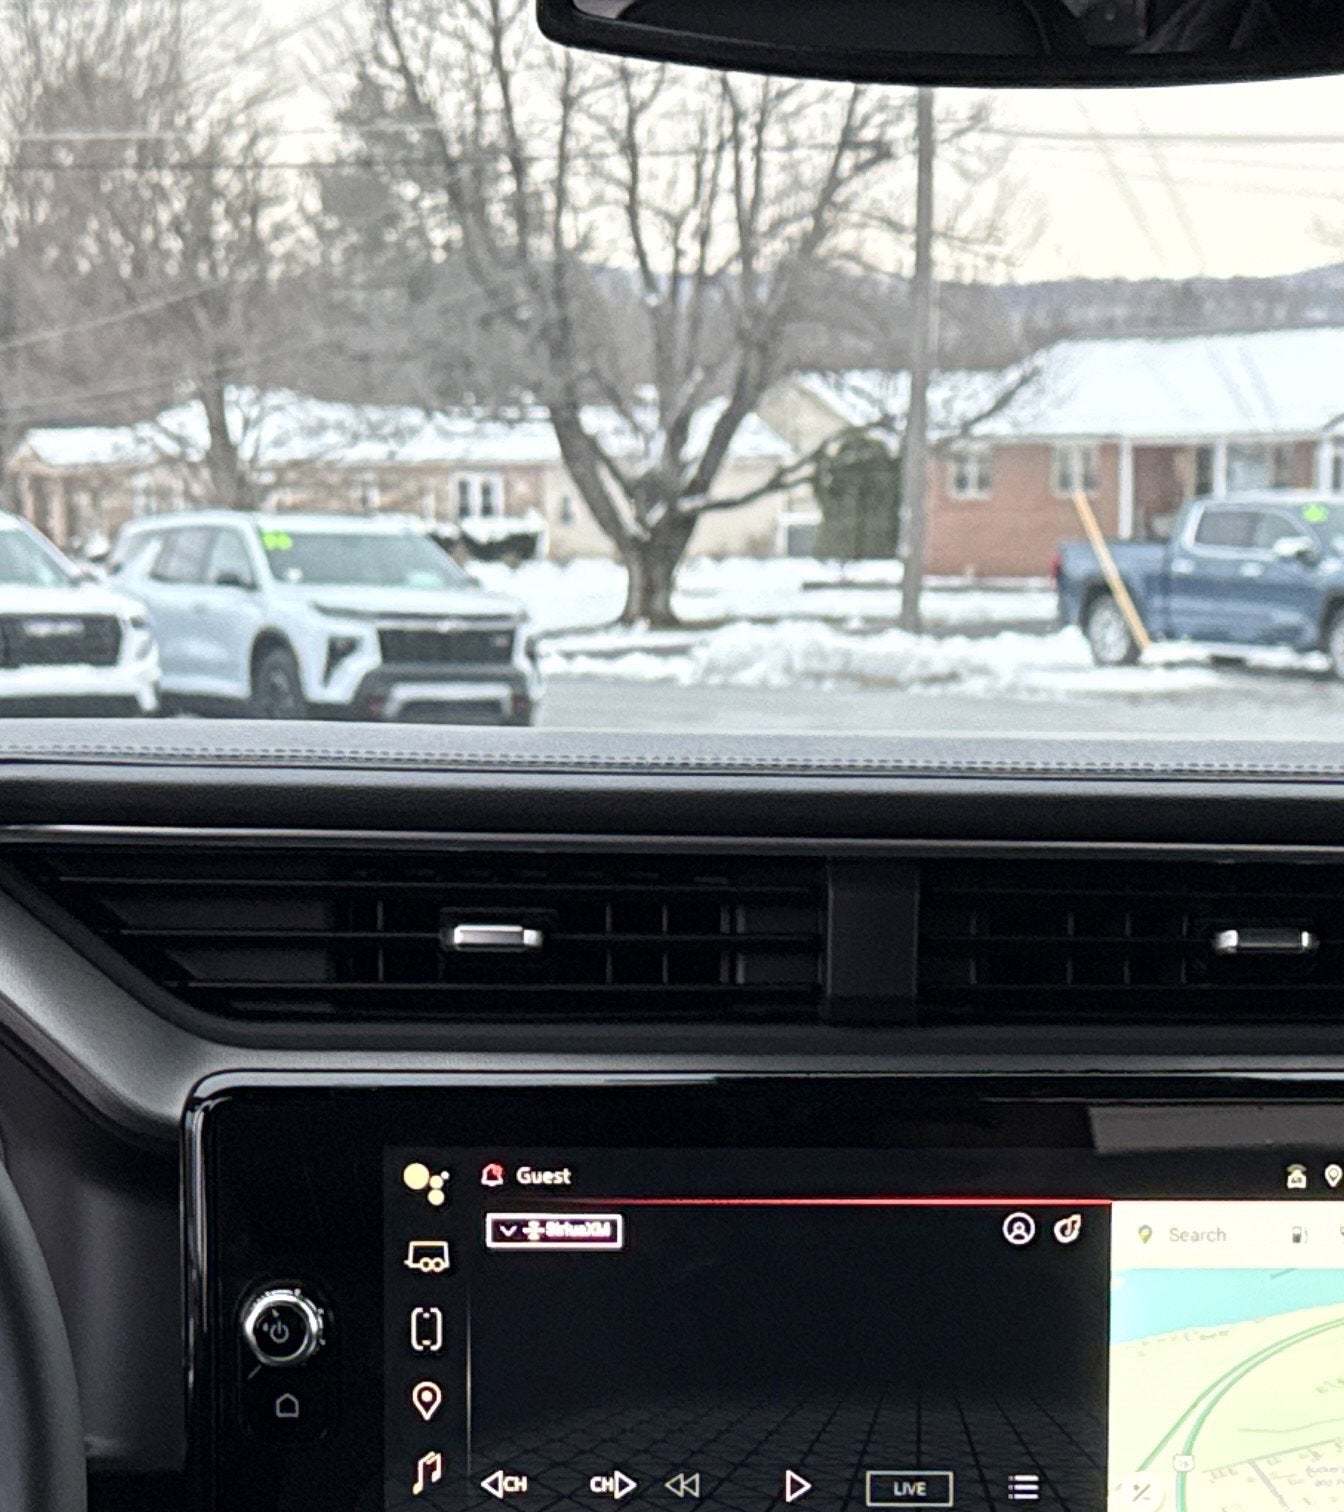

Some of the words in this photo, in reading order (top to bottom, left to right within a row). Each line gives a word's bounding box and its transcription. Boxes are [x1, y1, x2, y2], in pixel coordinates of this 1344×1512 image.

[516, 1166, 572, 1184] Guest
[1168, 1226, 1227, 1244] Search
[503, 1476, 528, 1492] CH
[590, 1476, 614, 1493] CH
[893, 1481, 927, 1496] LIVE
